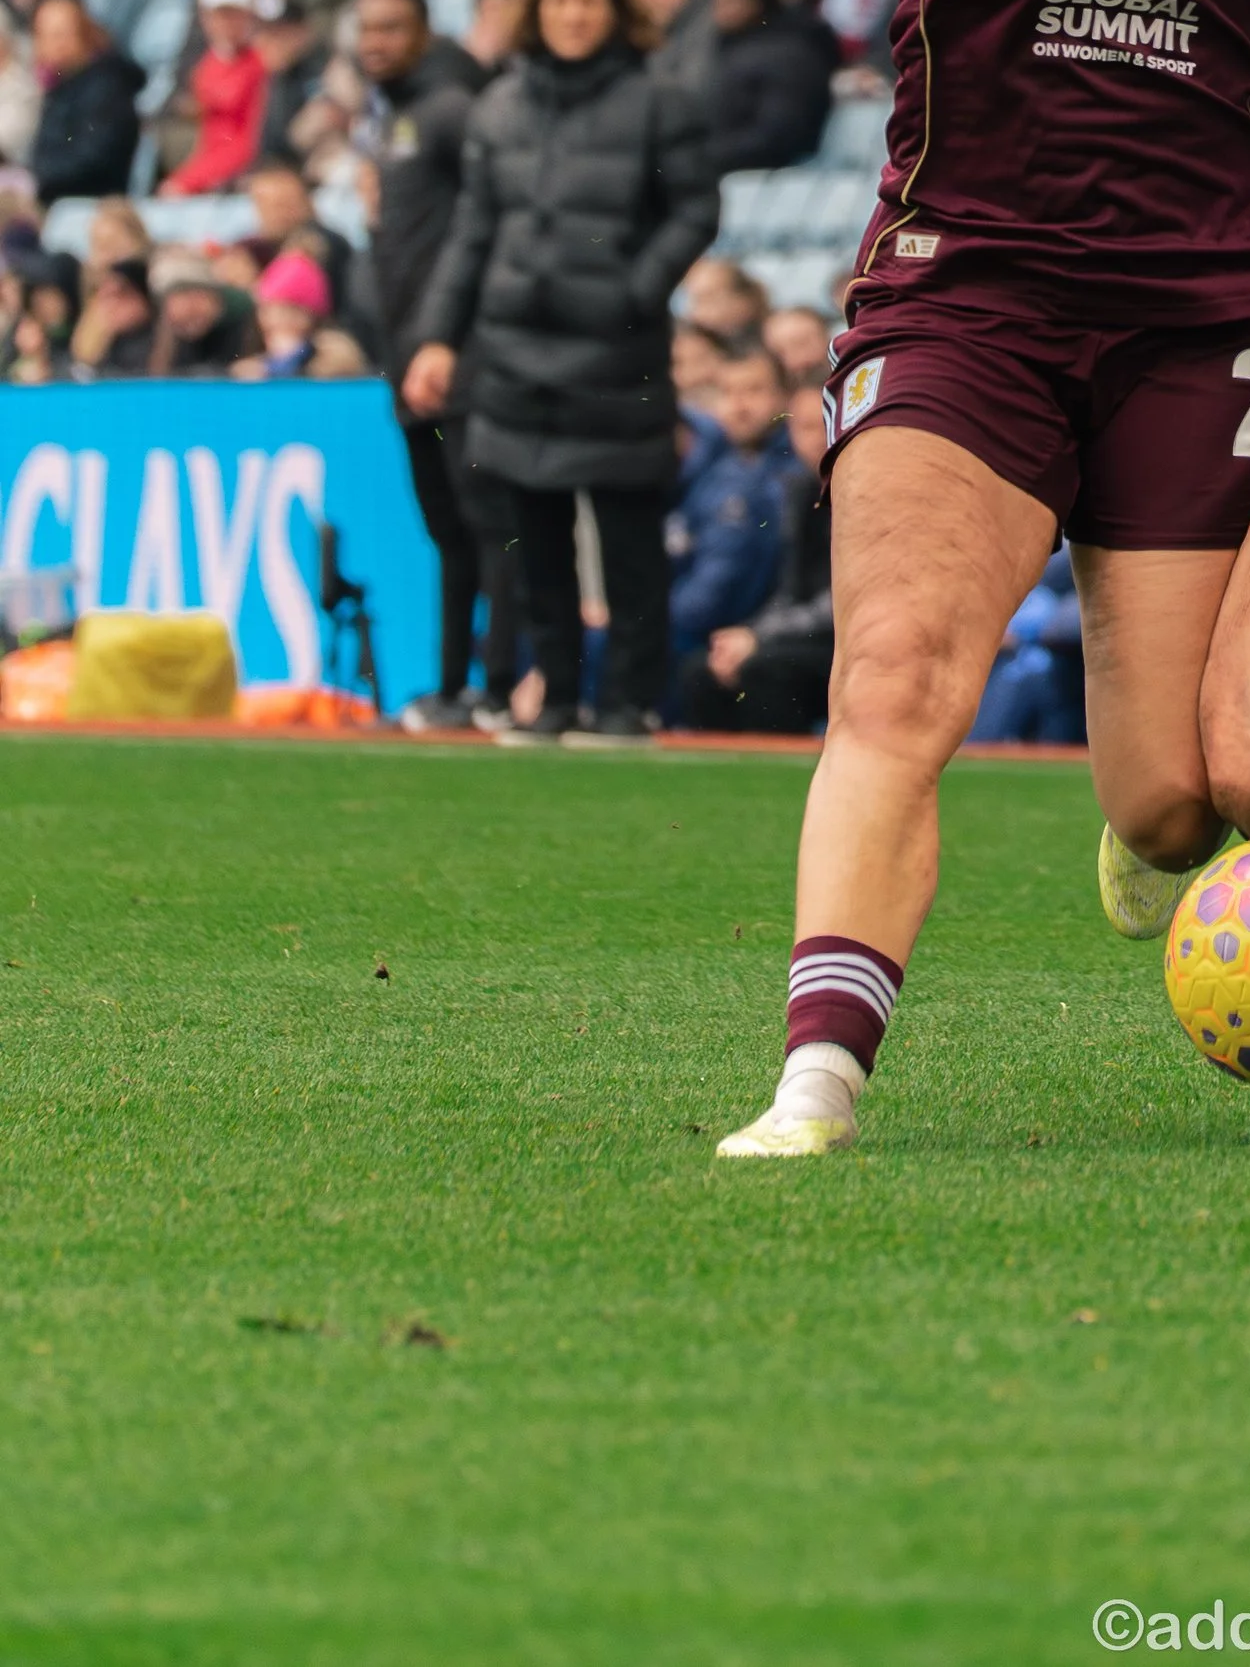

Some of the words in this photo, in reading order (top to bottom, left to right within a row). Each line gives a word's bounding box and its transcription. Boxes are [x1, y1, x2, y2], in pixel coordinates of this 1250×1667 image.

[1035, 6, 1199, 54] SUMMIT
[1032, 42, 1059, 57] ON
[1062, 44, 1131, 63] WOMEN
[1133, 52, 1145, 67] &
[1146, 55, 1197, 76] SPORT
